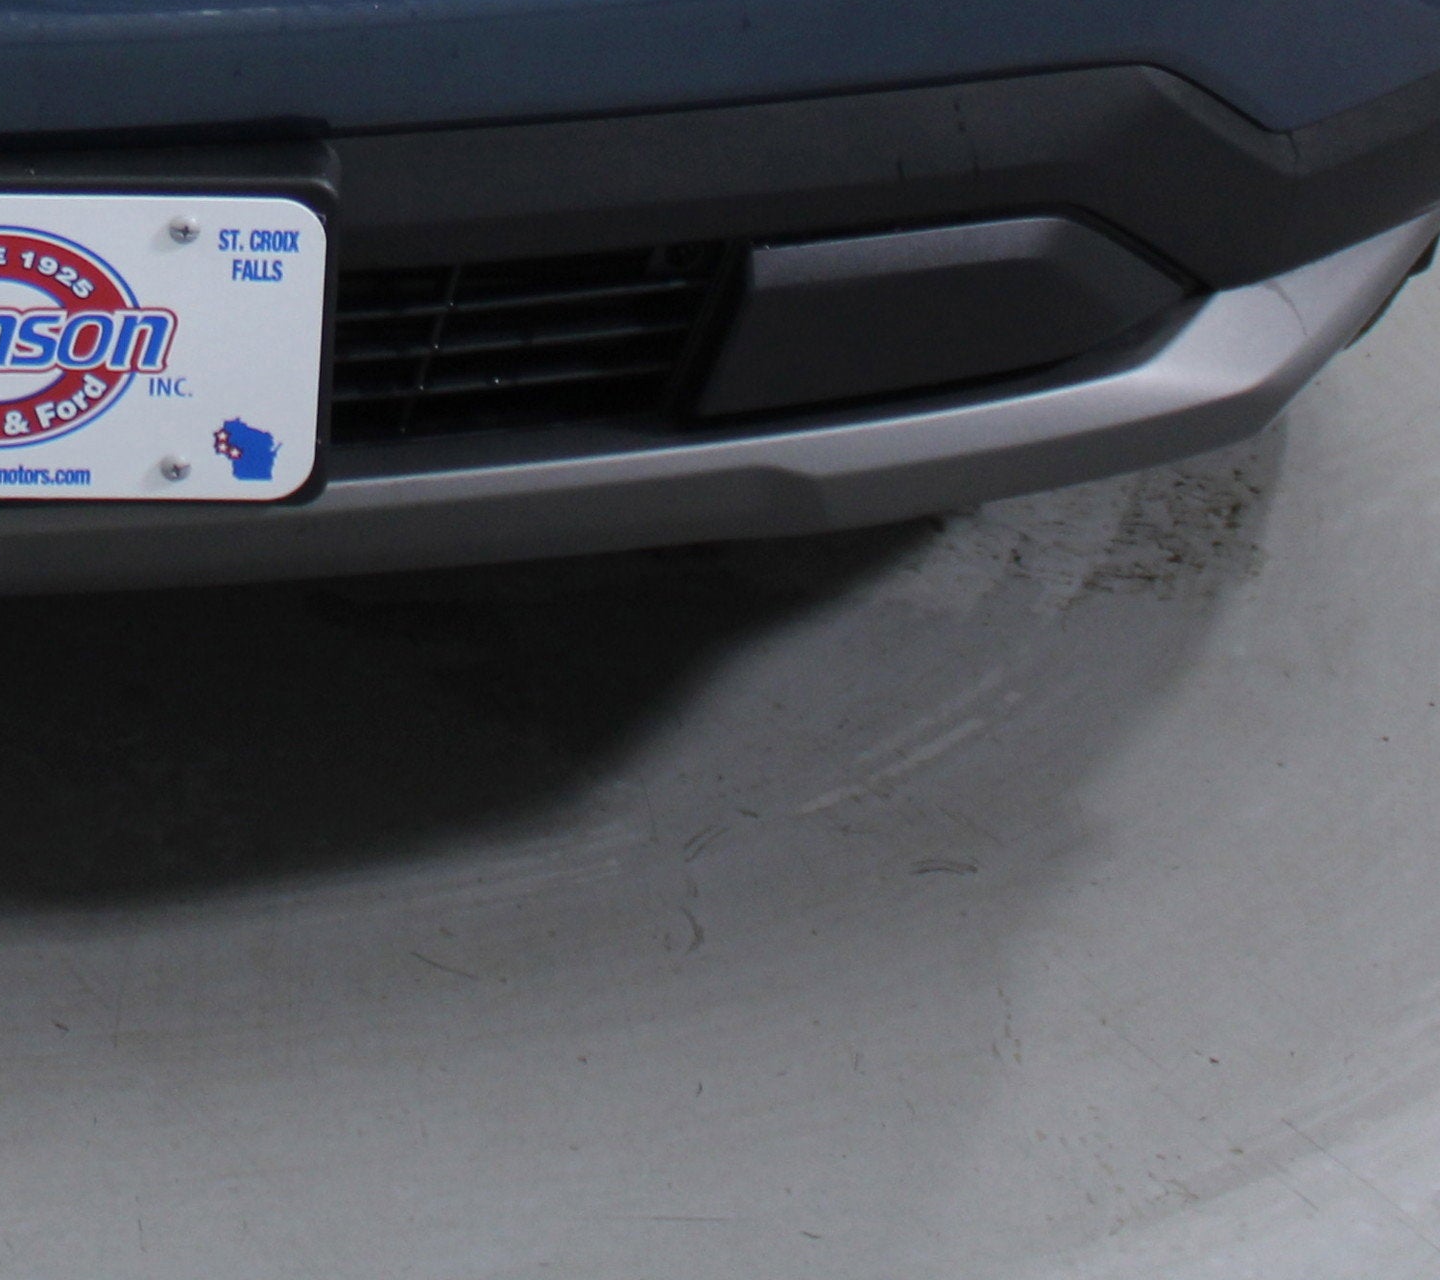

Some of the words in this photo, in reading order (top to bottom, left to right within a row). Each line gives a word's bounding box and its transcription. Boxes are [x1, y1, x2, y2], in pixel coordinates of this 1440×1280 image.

[218, 229, 244, 252] ST.
[250, 230, 299, 252] CROIX
[21, 251, 94, 299] 1925
[232, 259, 283, 282] FALLS
[148, 376, 193, 398] INC.
[3, 410, 29, 436] &
[35, 373, 107, 429] Ford
